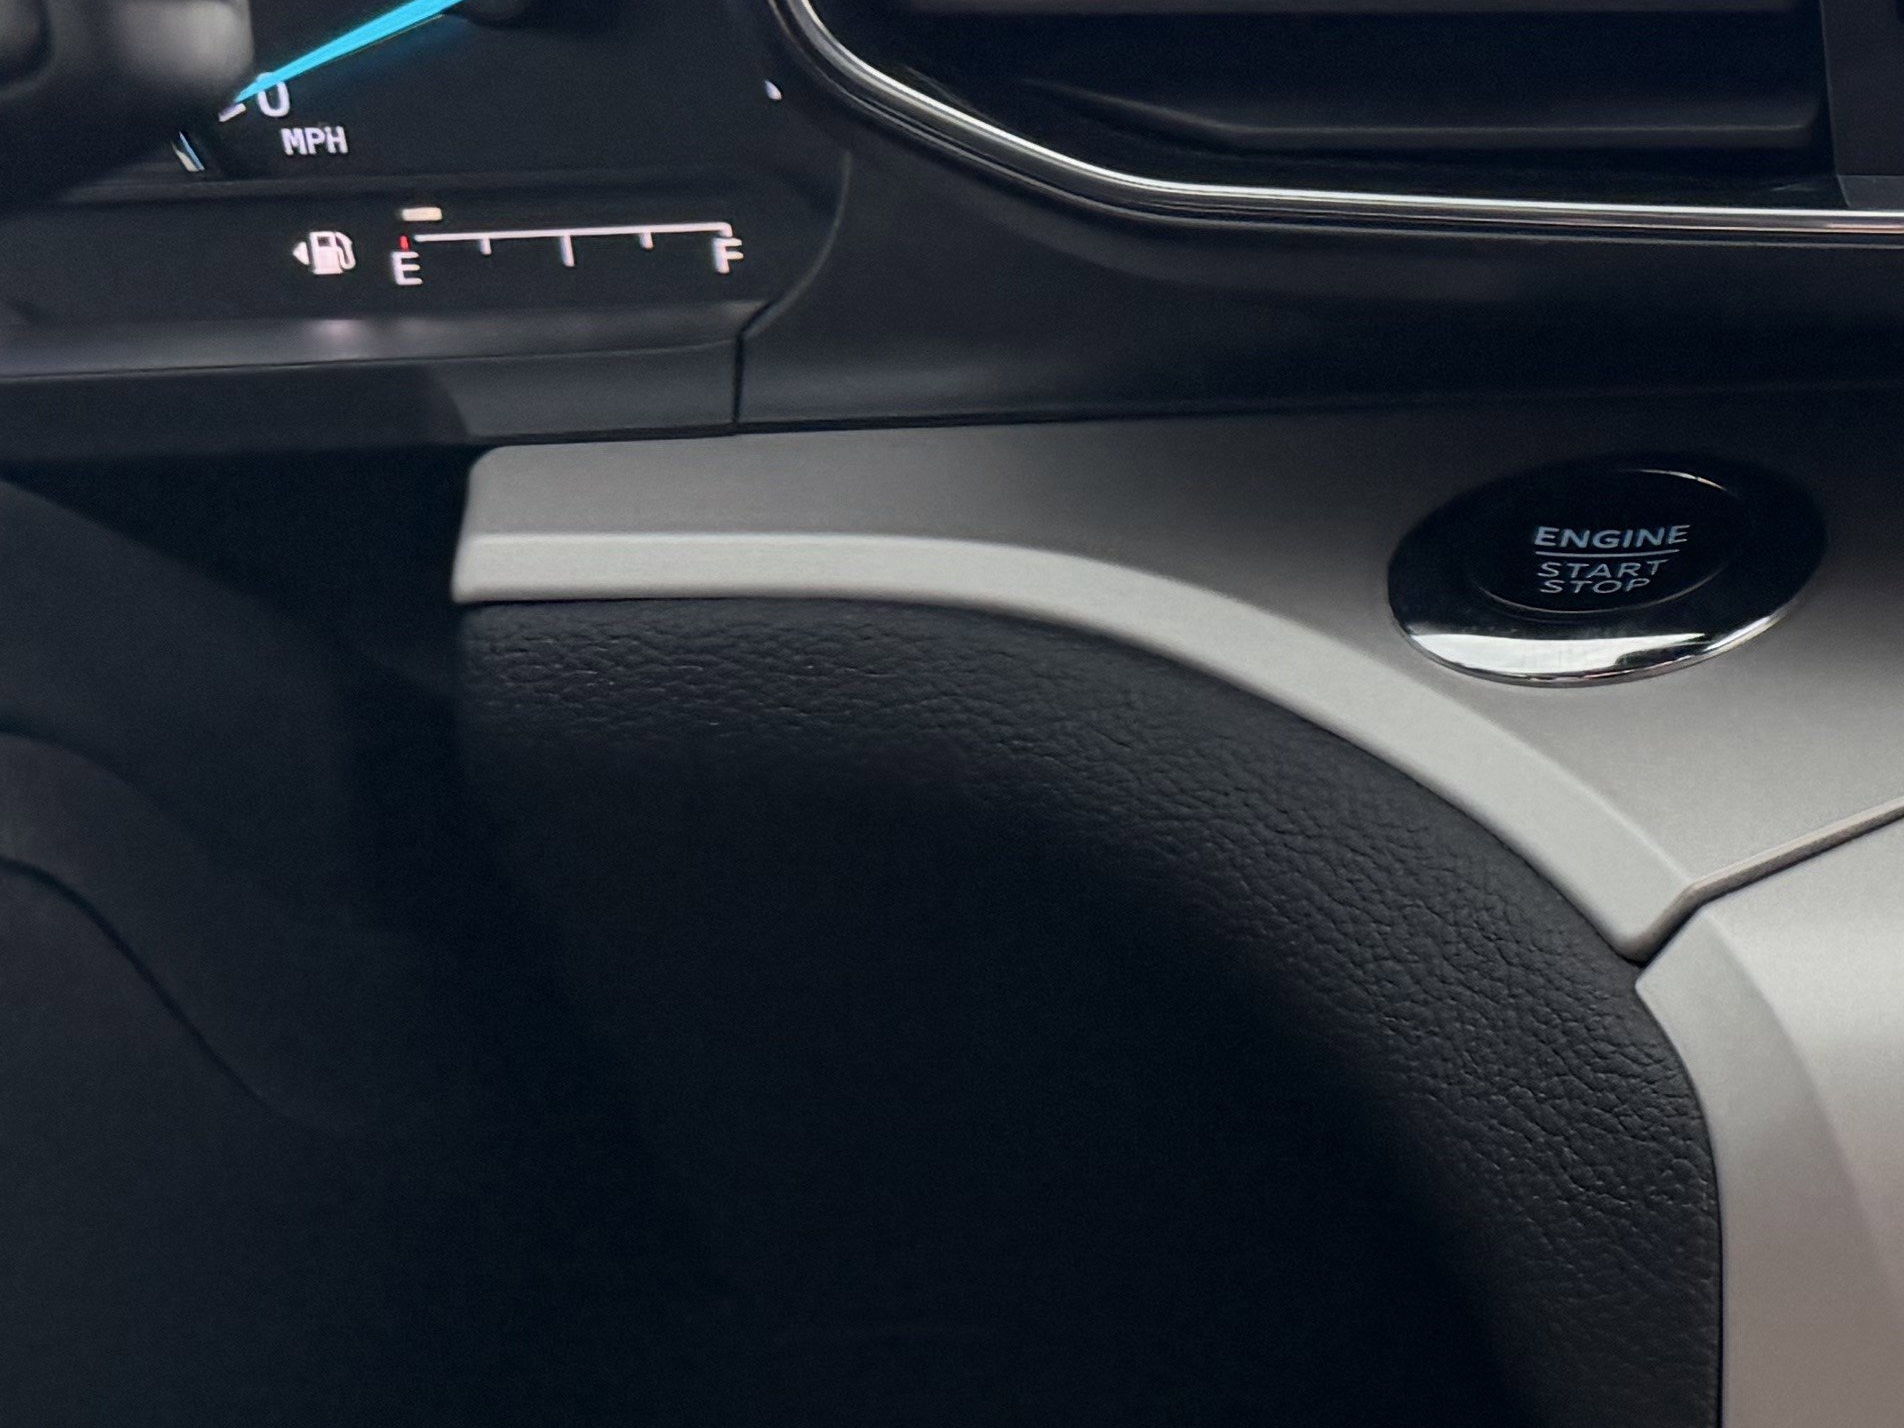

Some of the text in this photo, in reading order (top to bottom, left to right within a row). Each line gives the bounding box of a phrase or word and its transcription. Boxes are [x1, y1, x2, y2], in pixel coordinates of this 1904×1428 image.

[280, 126, 348, 155] MPH
[391, 252, 424, 286] E
[712, 236, 744, 274] F
[1533, 523, 1691, 550] ENGINE
[1536, 557, 1669, 580] START
[1539, 576, 1652, 595] STOP
